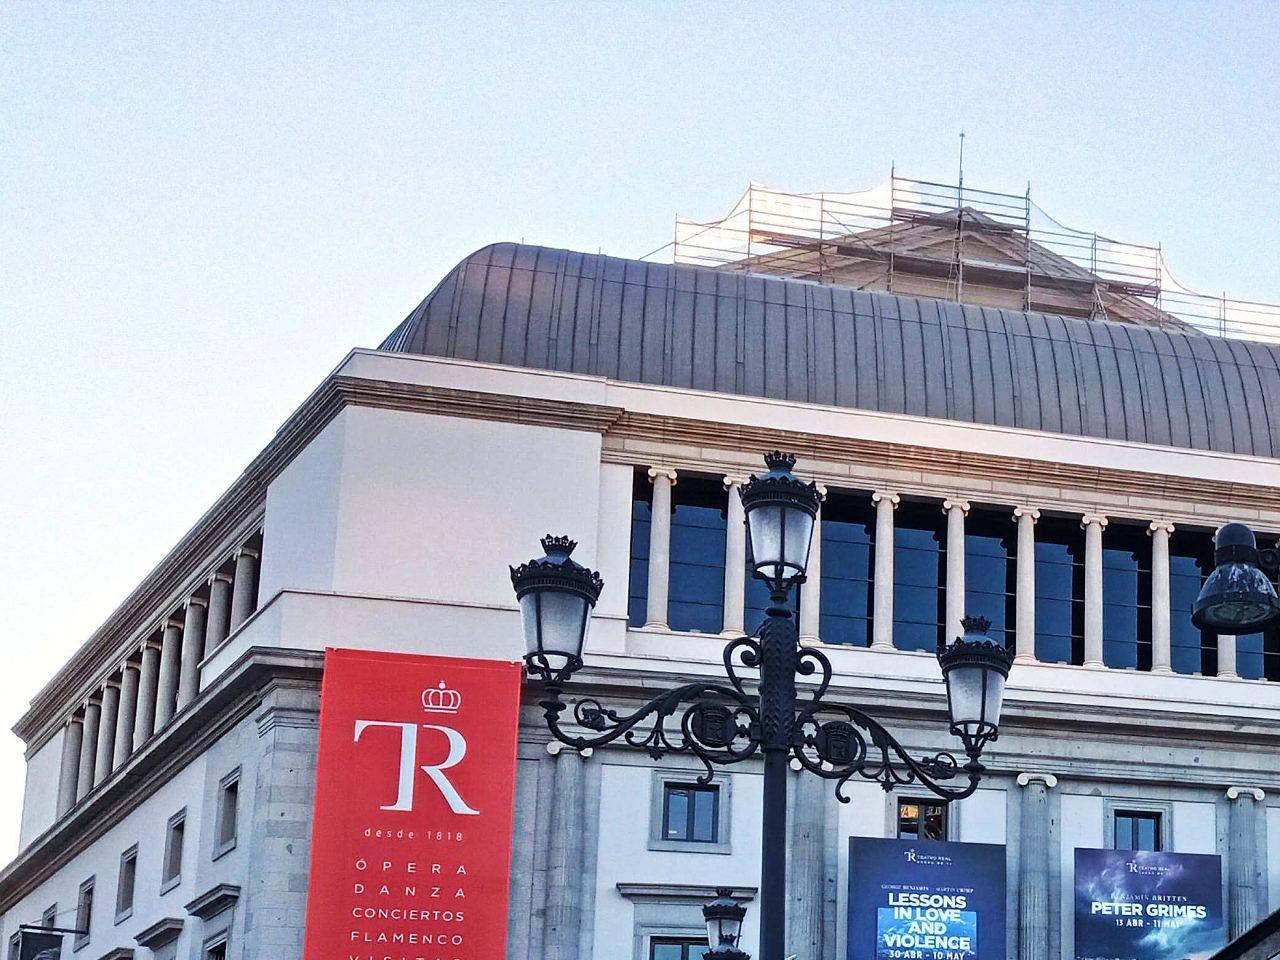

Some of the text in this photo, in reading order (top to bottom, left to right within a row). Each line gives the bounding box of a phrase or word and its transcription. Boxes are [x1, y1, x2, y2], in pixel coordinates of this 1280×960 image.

[364, 828, 463, 841] desde 1818
[354, 883, 465, 898] DANZA
[888, 892, 967, 909] LESSONS
[352, 907, 464, 922] CONCIERTOS
[893, 907, 961, 922] IN LOVE
[1091, 901, 1207, 919] PETER GRIMES
[908, 920, 947, 935] AND
[1116, 919, 1124, 927] 13
[1126, 919, 1143, 928] ABR
[1153, 920, 1160, 928] 11
[1162, 920, 1180, 929] MAY
[351, 931, 463, 945] FLAMENCO
[883, 933, 970, 950] VIOLENCE
[889, 950, 900, 959] 30
[904, 951, 922, 960] ABR
[933, 951, 943, 960] 10
[946, 951, 965, 960] MAY
